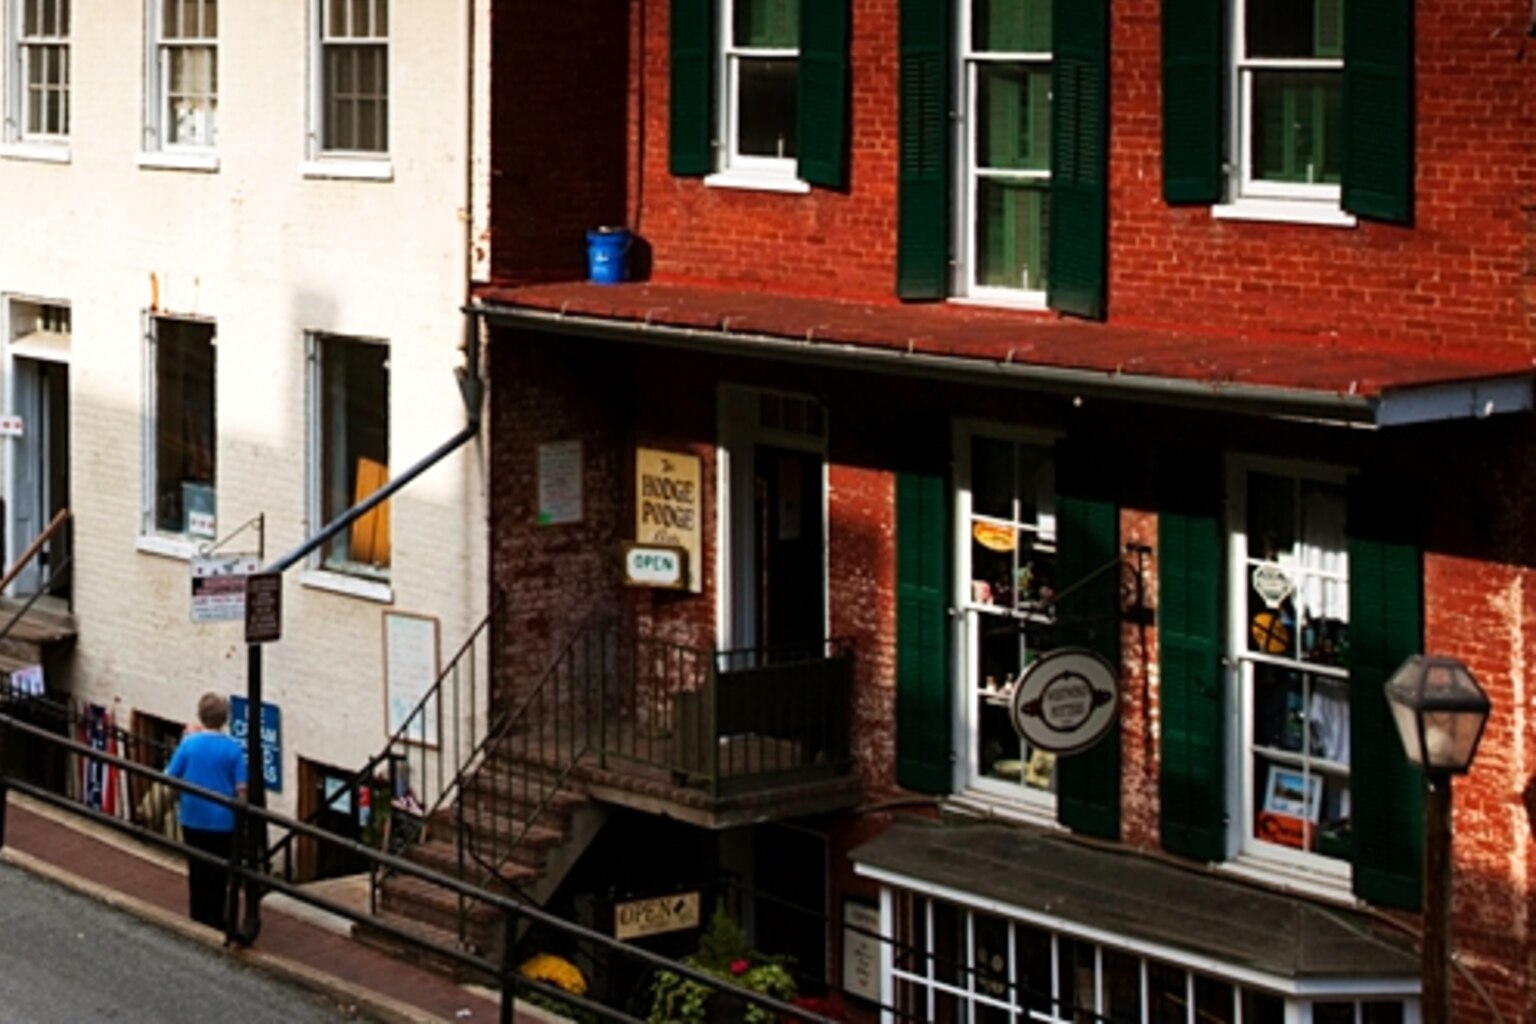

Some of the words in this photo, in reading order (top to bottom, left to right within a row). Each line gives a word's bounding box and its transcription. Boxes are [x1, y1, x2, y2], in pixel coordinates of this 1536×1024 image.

[642, 475, 694, 504] HODGE
[642, 500, 694, 531] PODGE
[634, 555, 673, 571] OPEN
[620, 899, 671, 926] OPEN
